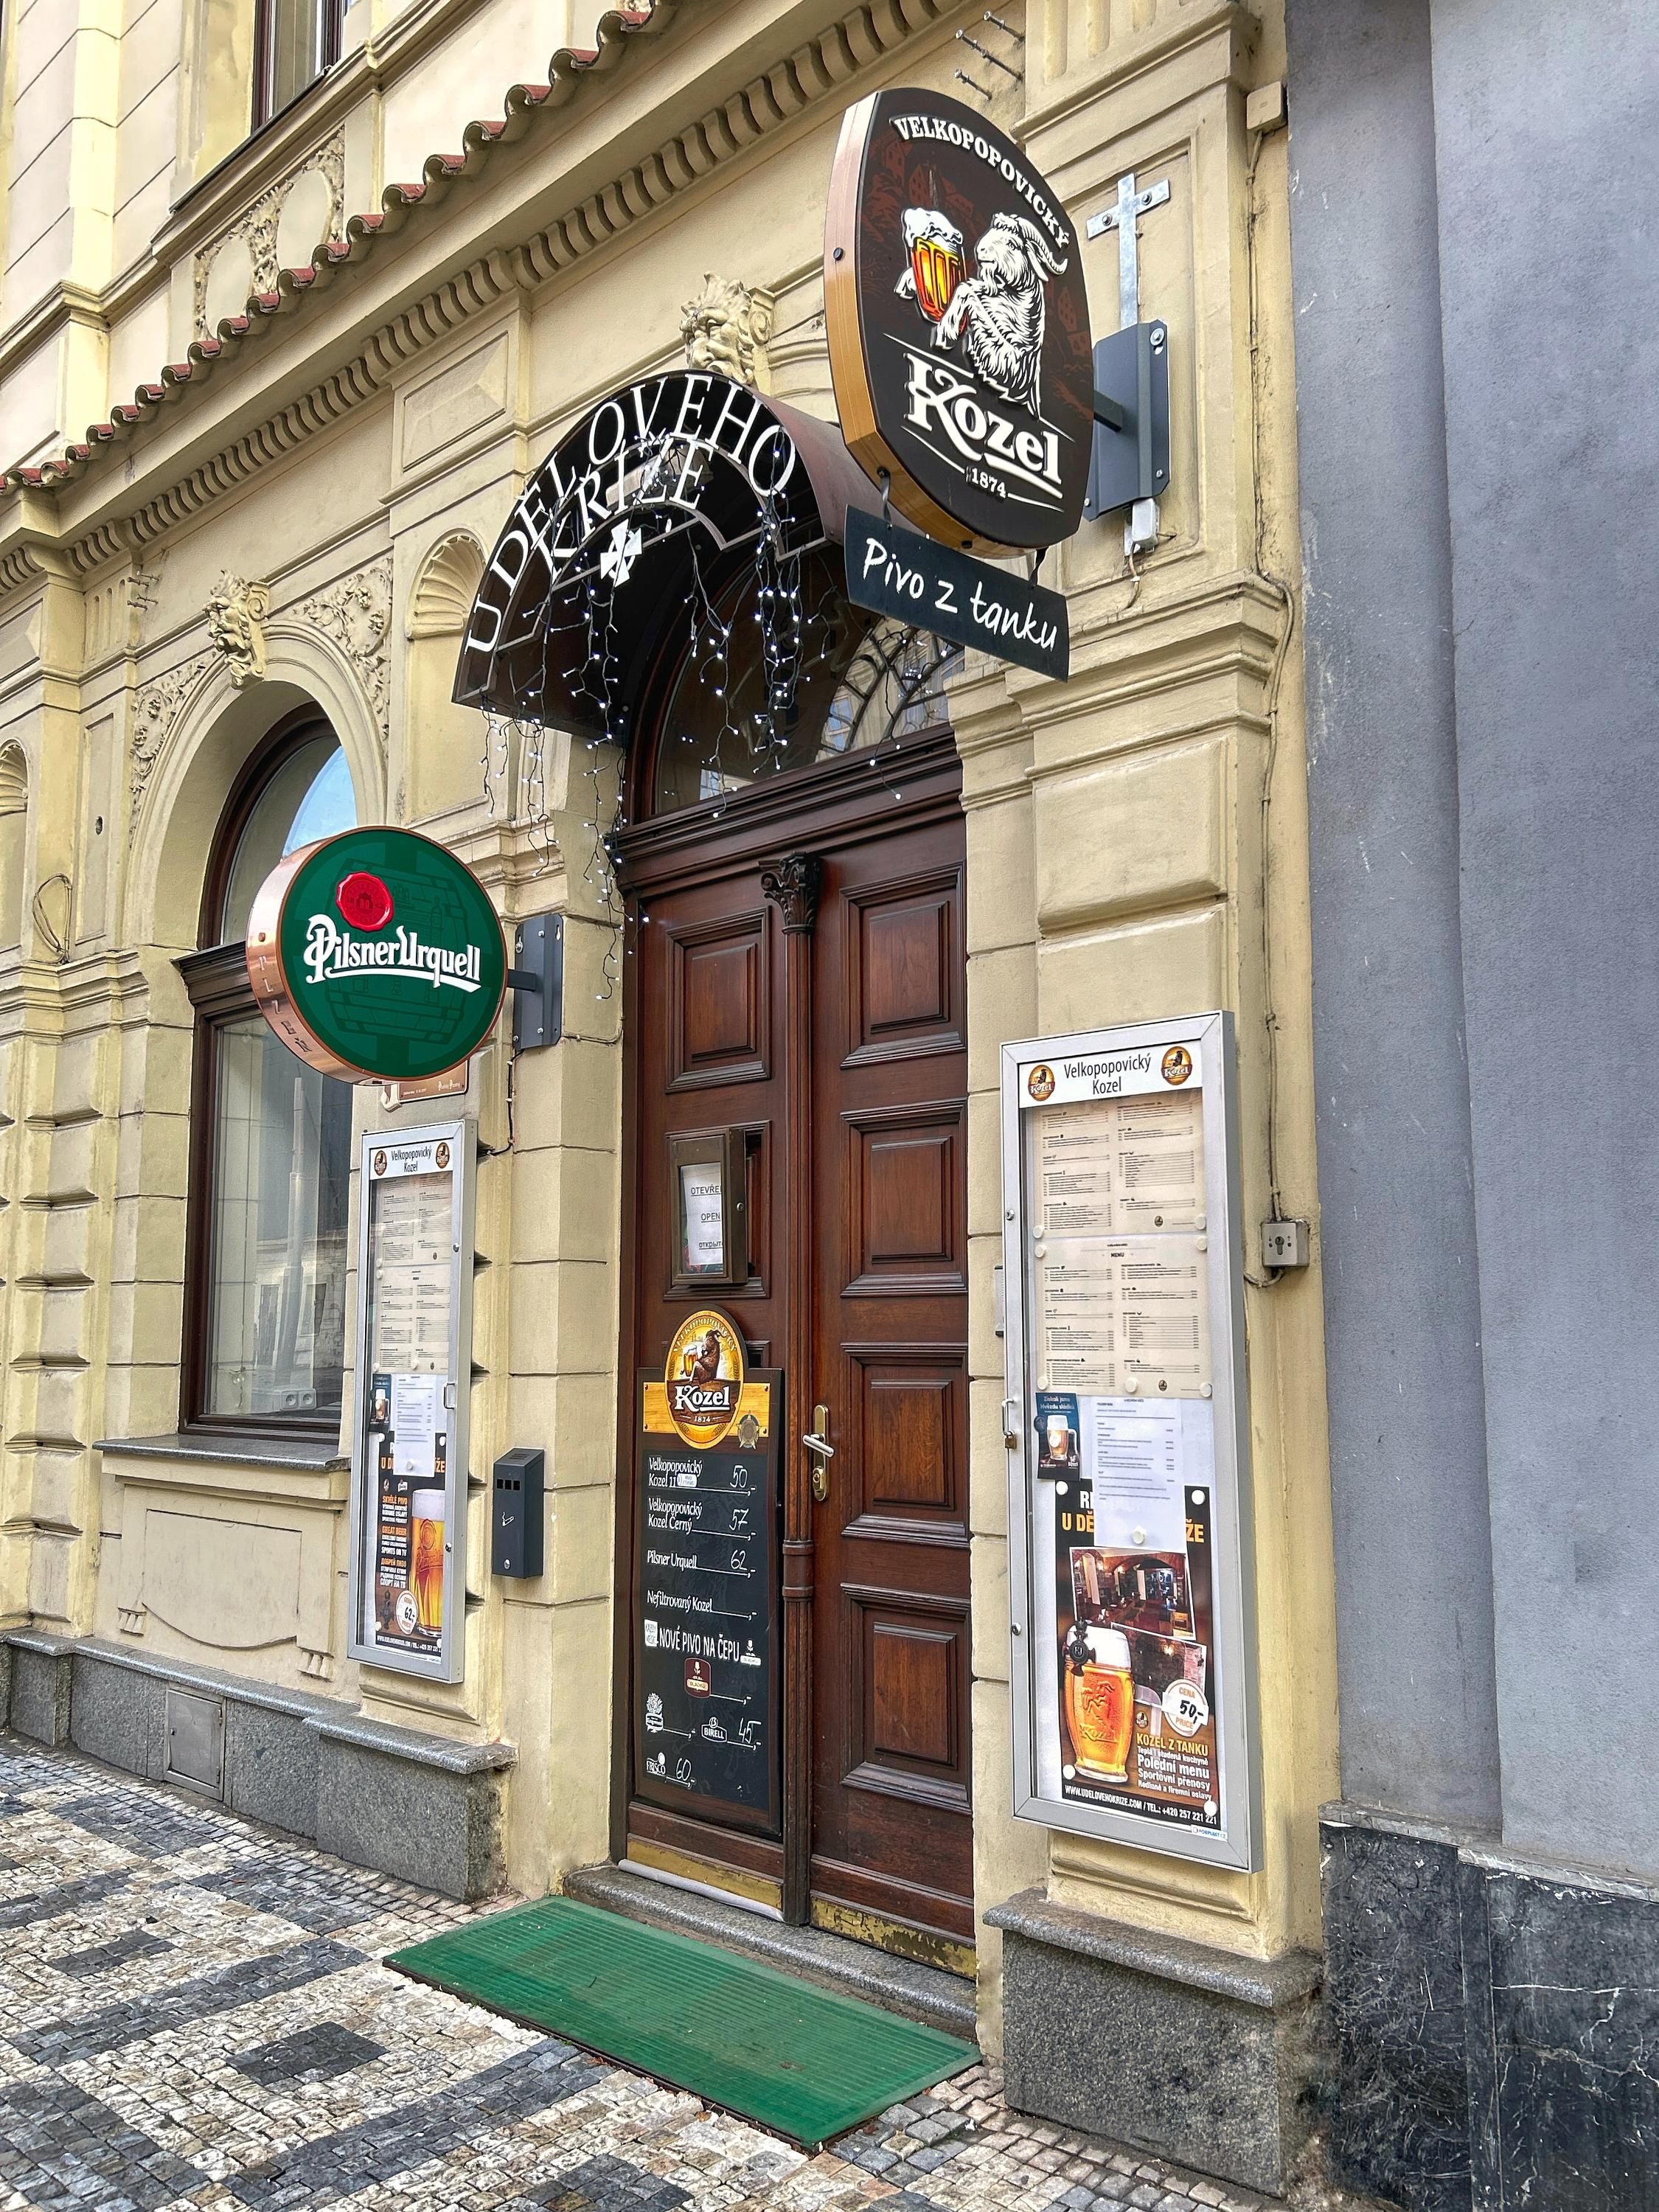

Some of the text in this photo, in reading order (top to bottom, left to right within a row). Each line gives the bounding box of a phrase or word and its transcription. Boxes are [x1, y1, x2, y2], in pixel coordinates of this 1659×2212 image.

[894, 116, 1069, 248] VELKOPOPOVICKÝ
[906, 352, 1062, 484] Kozel
[971, 467, 1006, 498] 1874
[863, 538, 924, 599] Pivo
[970, 581, 1057, 652] tanku
[465, 594, 501, 653] U
[304, 914, 481, 989] Pilsner Urquell
[1063, 1053, 1151, 1078] Velkopopovický
[1093, 1077, 1121, 1094] Kozel
[391, 1145, 432, 1161] Velkopopovický
[404, 1161, 418, 1172] Kozel
[691, 1183, 721, 1195] OTEVŘE
[701, 1211, 720, 1221] OPEN
[674, 1385, 731, 1412] Kozel
[649, 1457, 703, 1477] Velkopopovický
[649, 1473, 668, 1487] Kozel
[649, 1498, 703, 1520] Velkopopovický
[649, 1514, 668, 1528] Kozel
[669, 1512, 692, 1534] Černý
[1062, 1513, 1072, 1531] U
[647, 1550, 670, 1566] Pilsner
[671, 1554, 698, 1571] Urquell
[647, 1590, 713, 1613] Nefiltrovaný Kozel
[659, 1625, 681, 1651] NOVÉ
[682, 1632, 700, 1655] PIVO
[703, 1636, 715, 1658] NA
[717, 1633, 740, 1661] ČEPU
[704, 1728, 724, 1739] BIRELL
[1136, 1732, 1208, 1756] KOZEL Z TANKU
[647, 1760, 666, 1774] FRISCO
[1138, 1753, 1210, 1779] Polední menu
[1158, 1750, 1181, 1761] studená
[1182, 1753, 1208, 1766] kuchyně
[1138, 1767, 1211, 1792] Sportovní přenosy
[1065, 1784, 1142, 1810] WWW.UDELOVEHOKRIZE.COM
[1162, 1806, 1178, 1818] +420
[1179, 1809, 1192, 1820] 257
[1192, 1812, 1203, 1823] 221
[1192, 1791, 1211, 1801] oslavy
